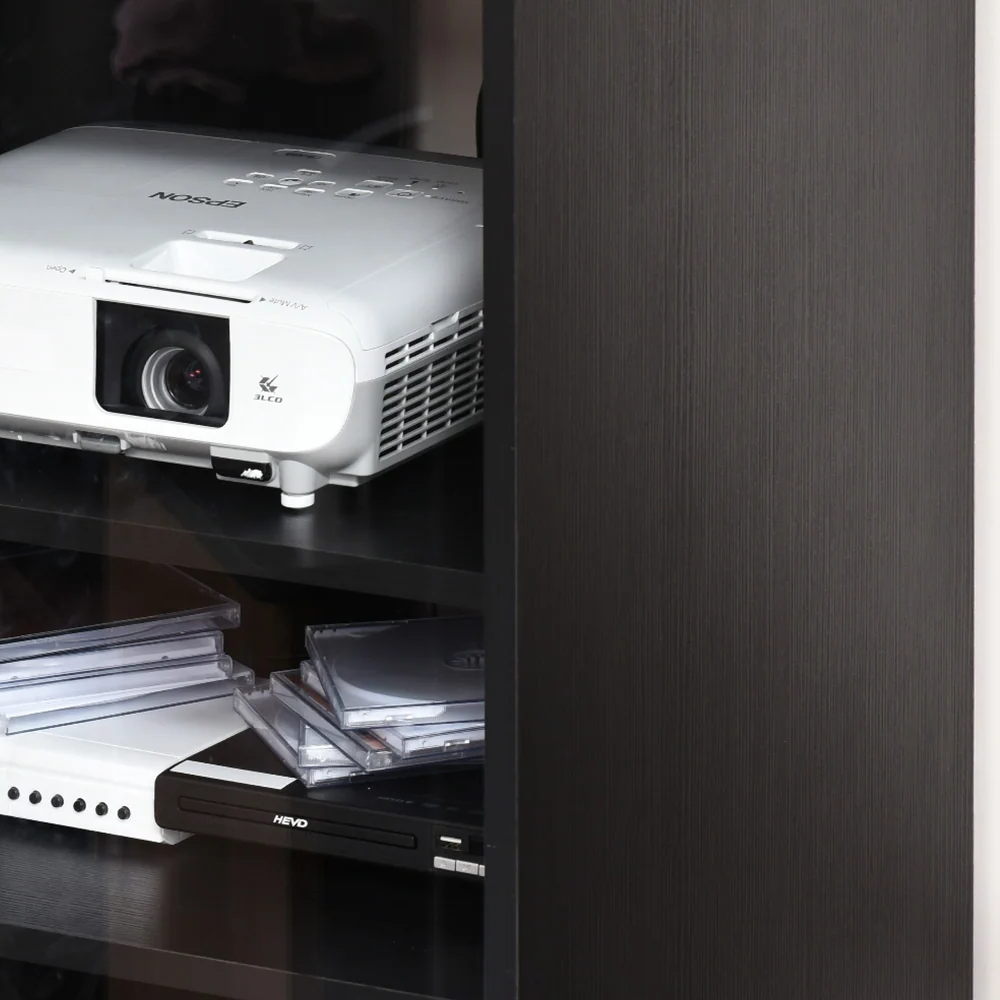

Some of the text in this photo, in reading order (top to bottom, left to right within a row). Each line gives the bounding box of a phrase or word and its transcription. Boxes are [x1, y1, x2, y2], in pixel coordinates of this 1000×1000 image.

[149, 191, 247, 208] EPSON
[253, 393, 283, 403] 3LCD
[273, 815, 308, 828] HEVD
